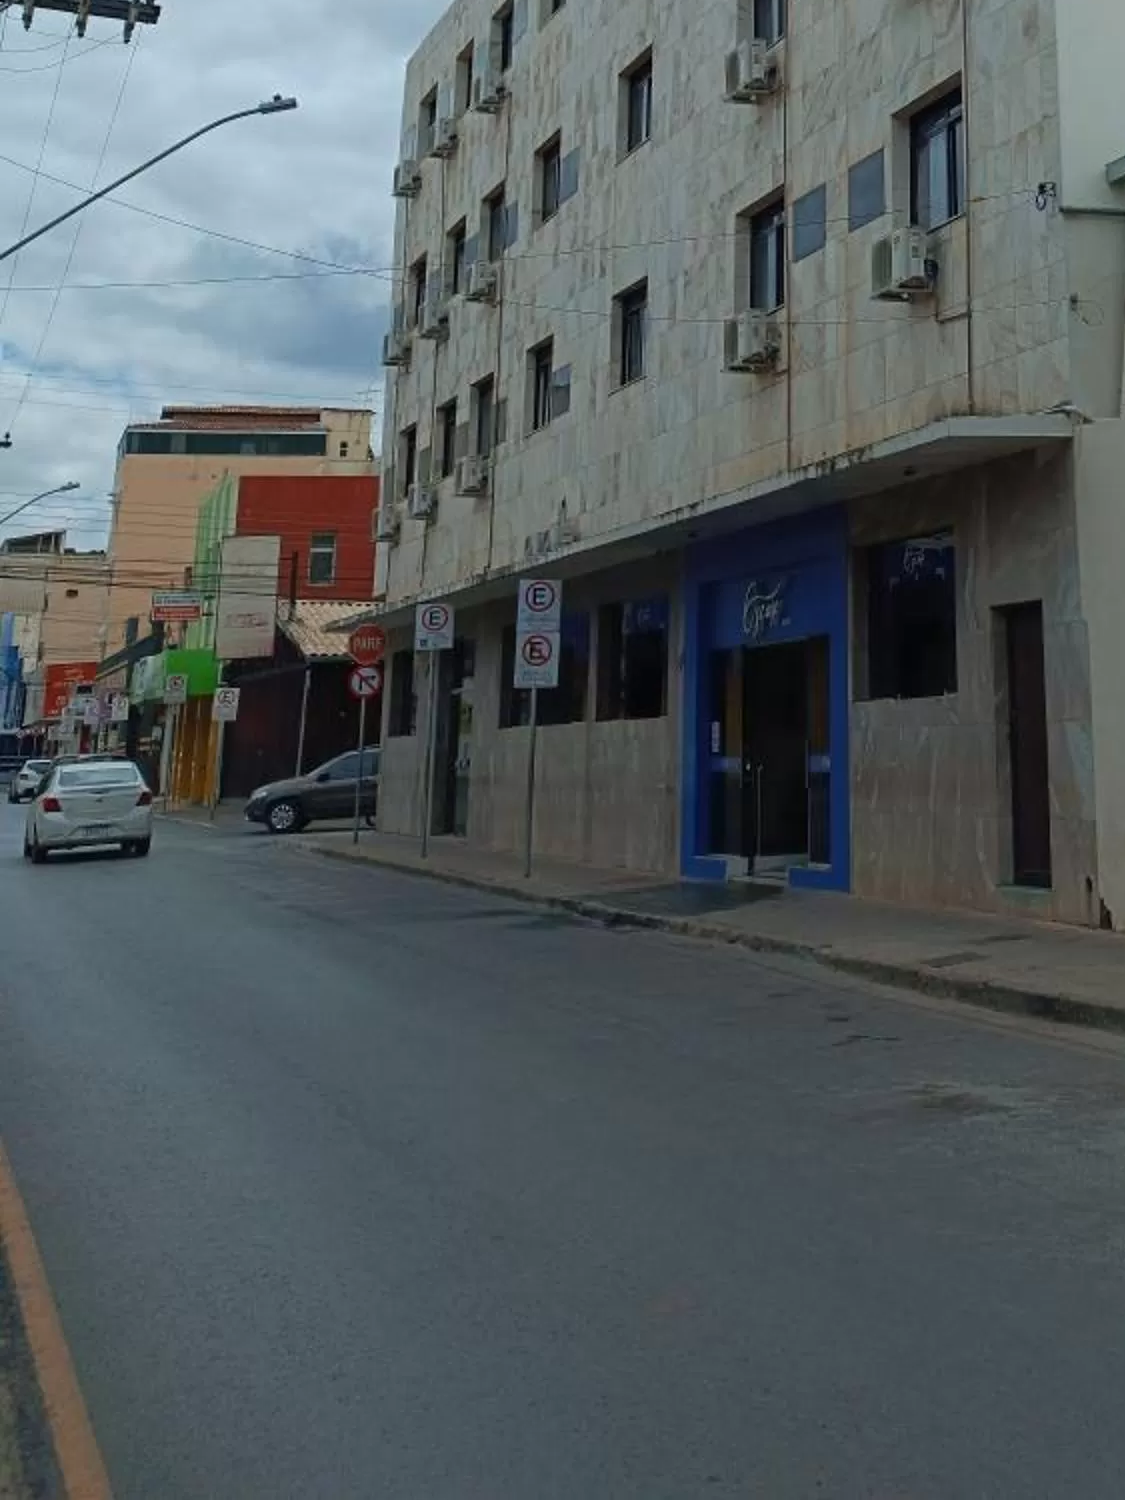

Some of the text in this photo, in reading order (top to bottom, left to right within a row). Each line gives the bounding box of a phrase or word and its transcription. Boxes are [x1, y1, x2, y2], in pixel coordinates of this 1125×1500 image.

[533, 587, 547, 606] E
[429, 610, 442, 626] E
[352, 635, 384, 652] PARE
